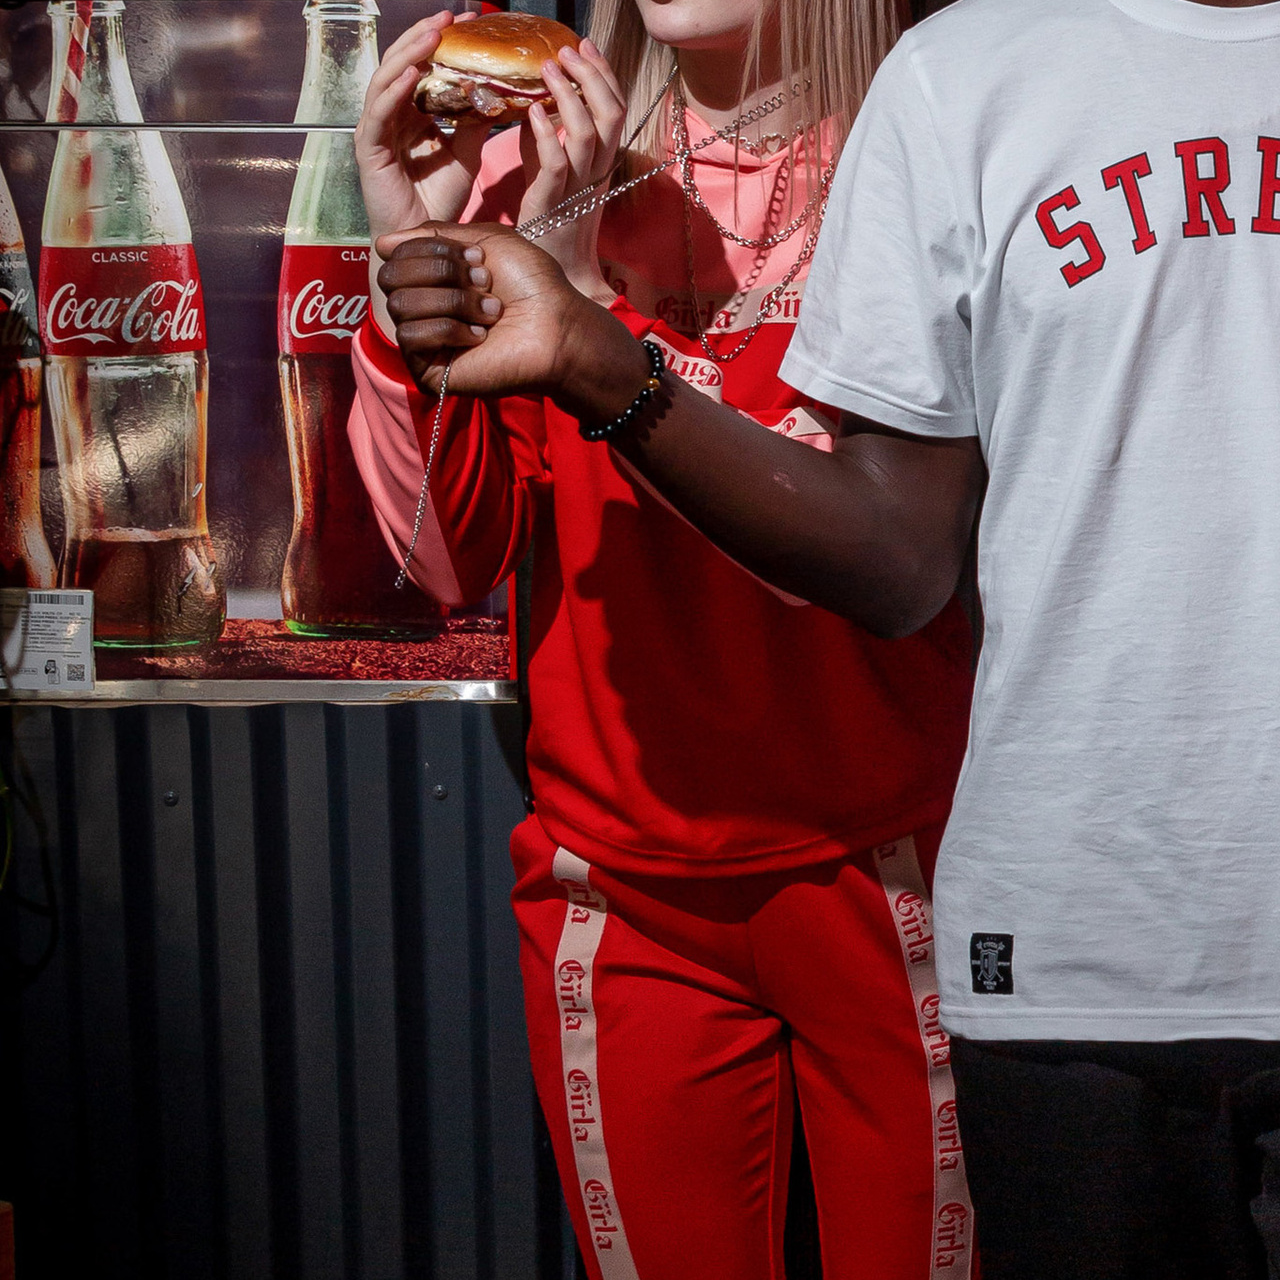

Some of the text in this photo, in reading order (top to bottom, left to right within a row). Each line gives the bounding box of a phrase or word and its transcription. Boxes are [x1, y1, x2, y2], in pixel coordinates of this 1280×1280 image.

[92, 251, 149, 263] CLASSIC
[341, 251, 371, 261] CLA
[46, 279, 200, 345] Coca-Cola
